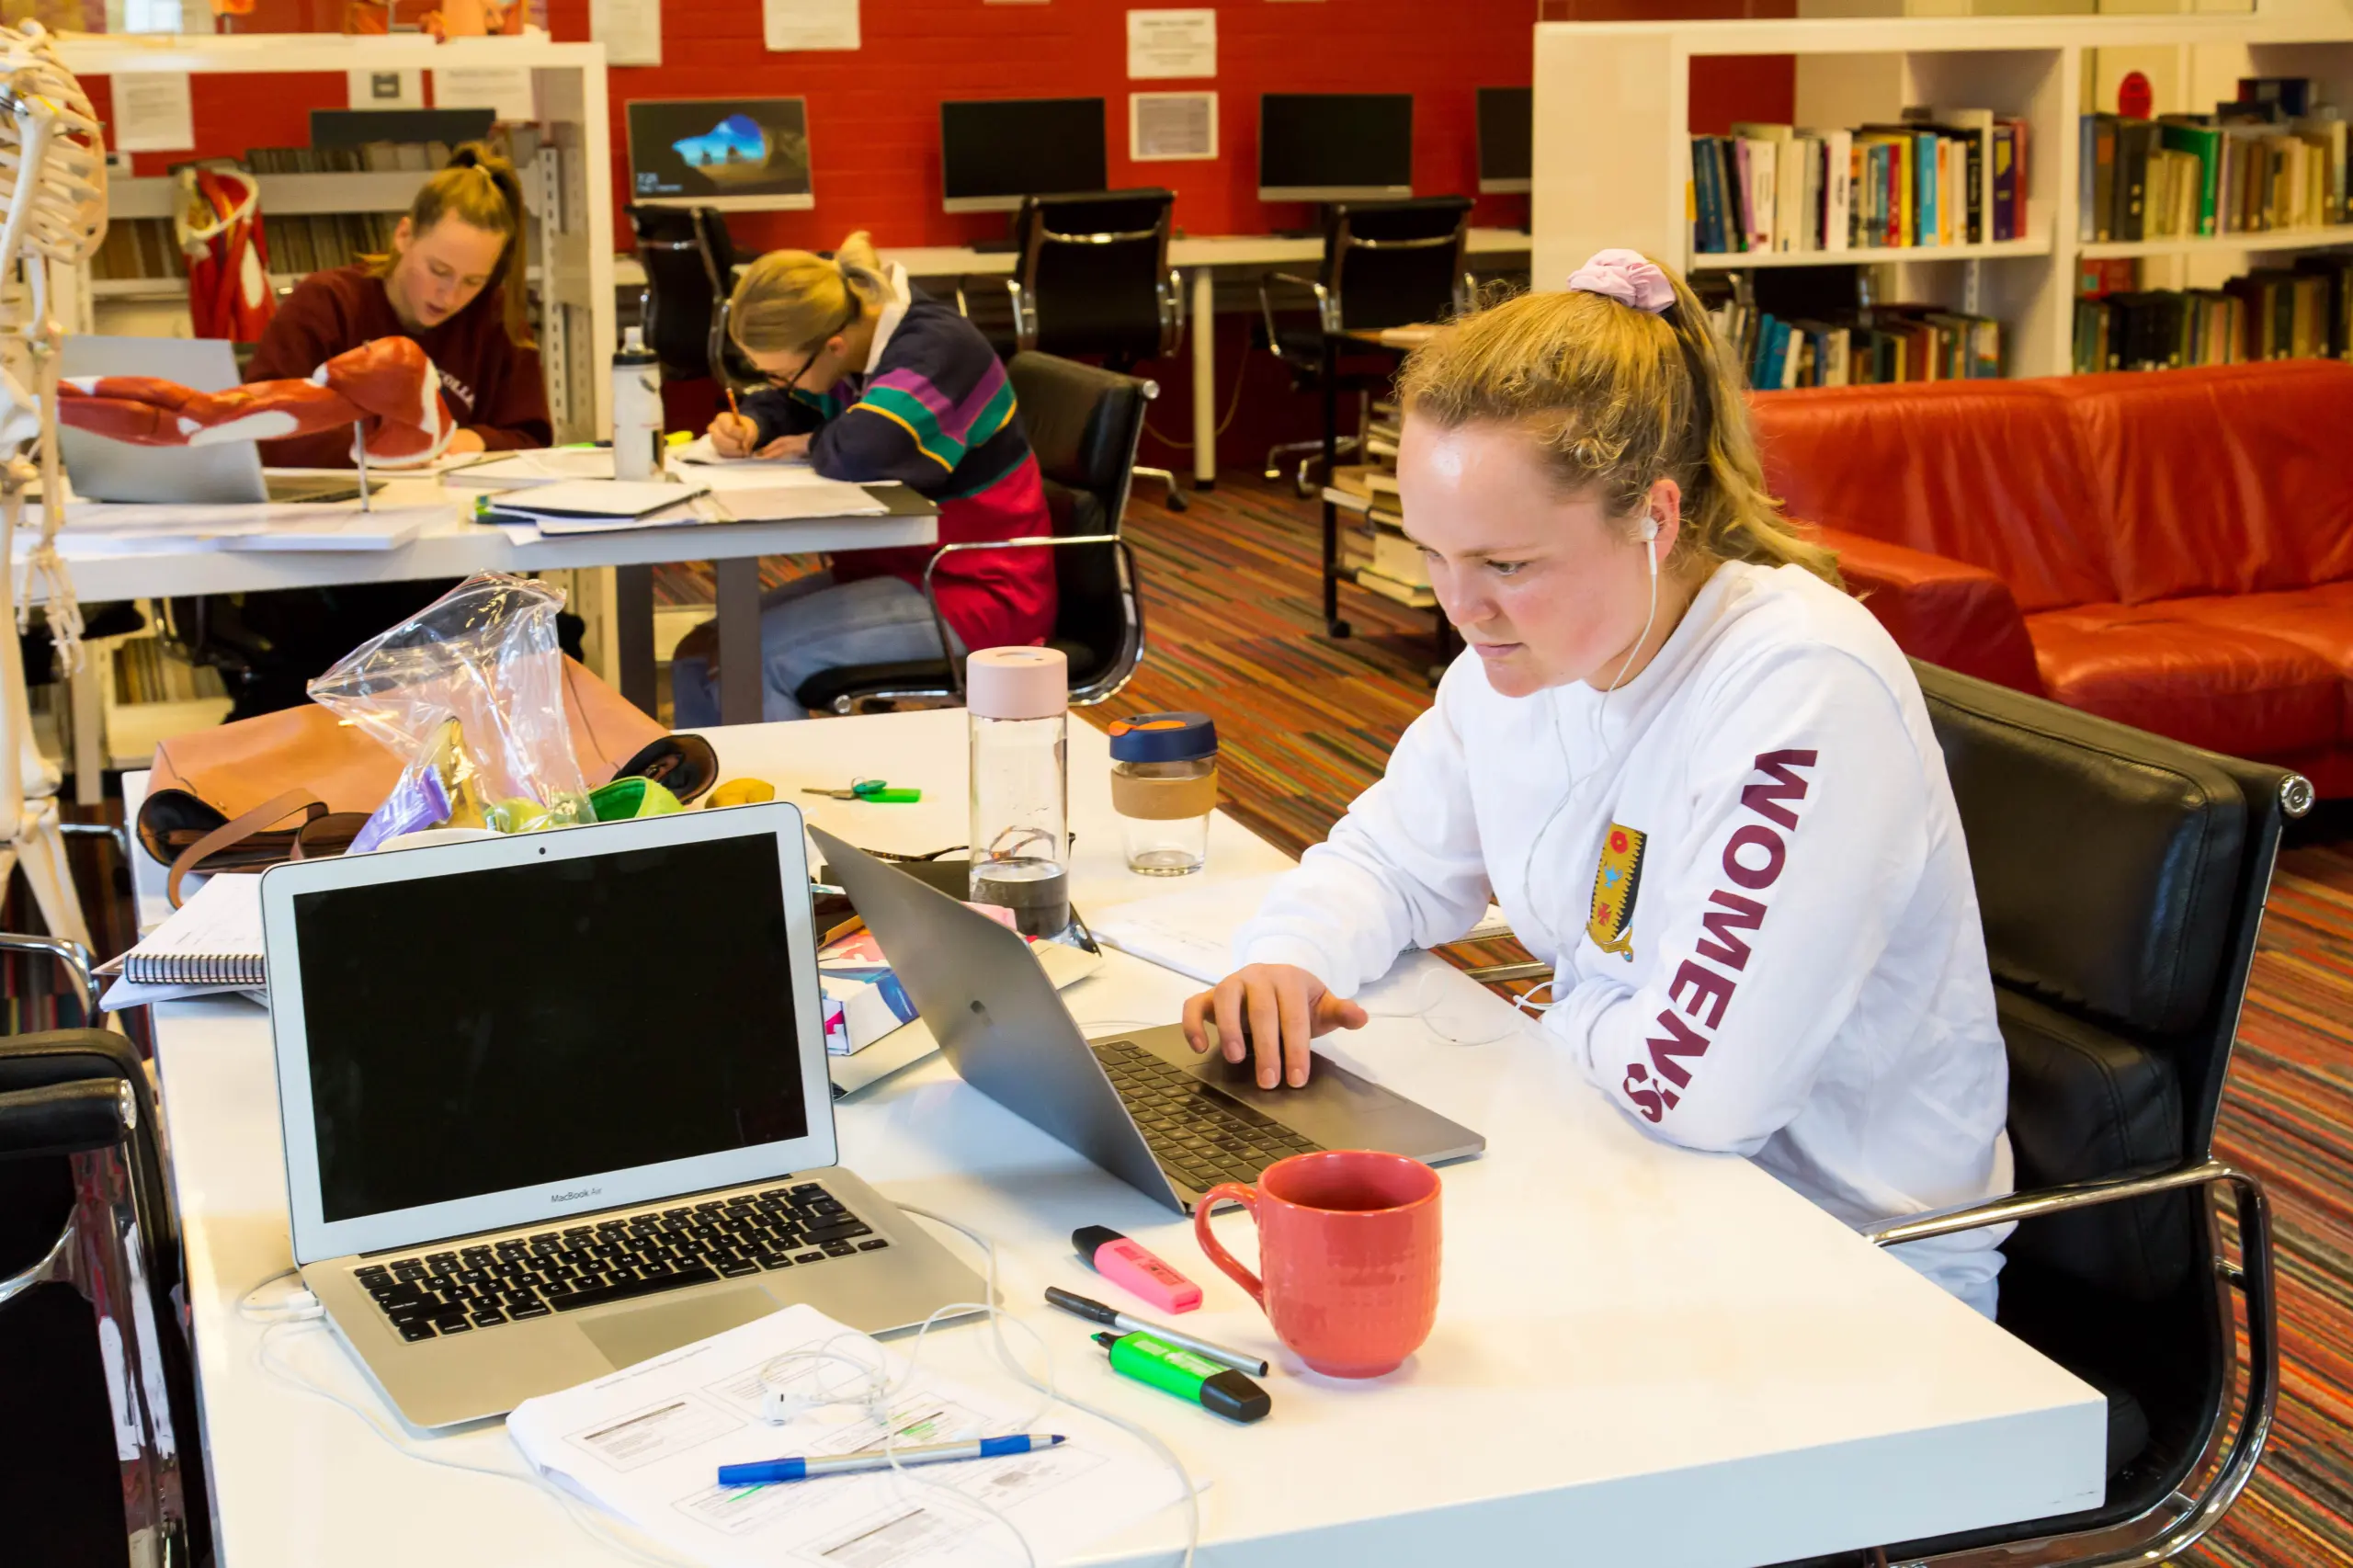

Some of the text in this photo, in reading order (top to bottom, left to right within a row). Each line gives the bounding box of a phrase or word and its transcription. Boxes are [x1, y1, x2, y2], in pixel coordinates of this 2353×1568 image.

[1622, 749, 1818, 1123] WOMEN'S
[551, 1187, 602, 1203] MacBook Air
